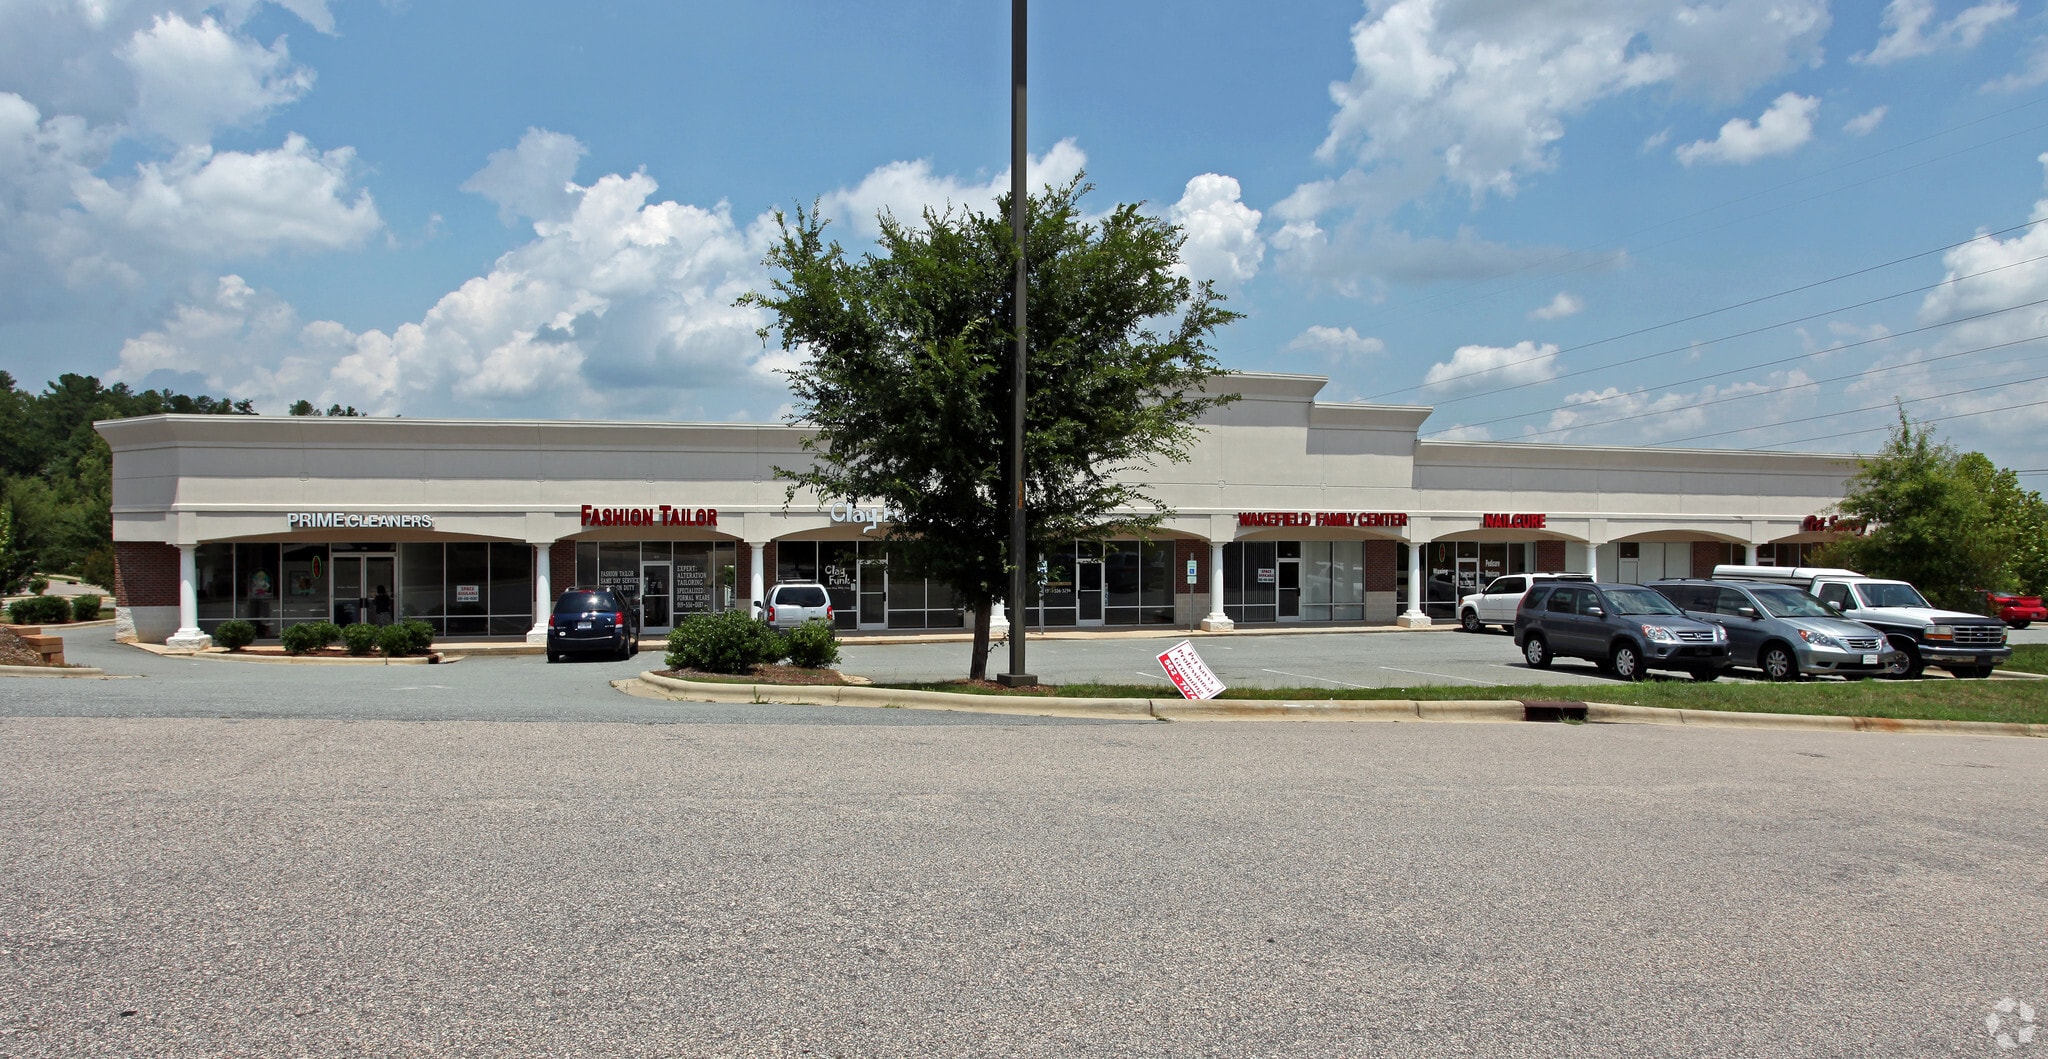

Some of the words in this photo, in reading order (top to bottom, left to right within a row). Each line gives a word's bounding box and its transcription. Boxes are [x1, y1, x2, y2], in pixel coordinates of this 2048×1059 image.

[287, 512, 345, 528] PRIME
[347, 514, 433, 528] CLEANERS
[581, 505, 654, 527] FASHION
[659, 505, 718, 527] TAILOR
[831, 501, 877, 533] Clay
[1238, 512, 1311, 527] WAKEFIELD
[1315, 512, 1357, 527] FAMILY
[1358, 512, 1408, 527] CENTER
[1803, 515, 1826, 531] Pet
[824, 565, 846, 578] Clay
[829, 574, 851, 585] Funk
[1174, 657, 1204, 695] Grooming
[1177, 649, 1213, 693] Professional
[1188, 652, 1198, 665] Pet
[1198, 665, 1214, 685] Savvy
